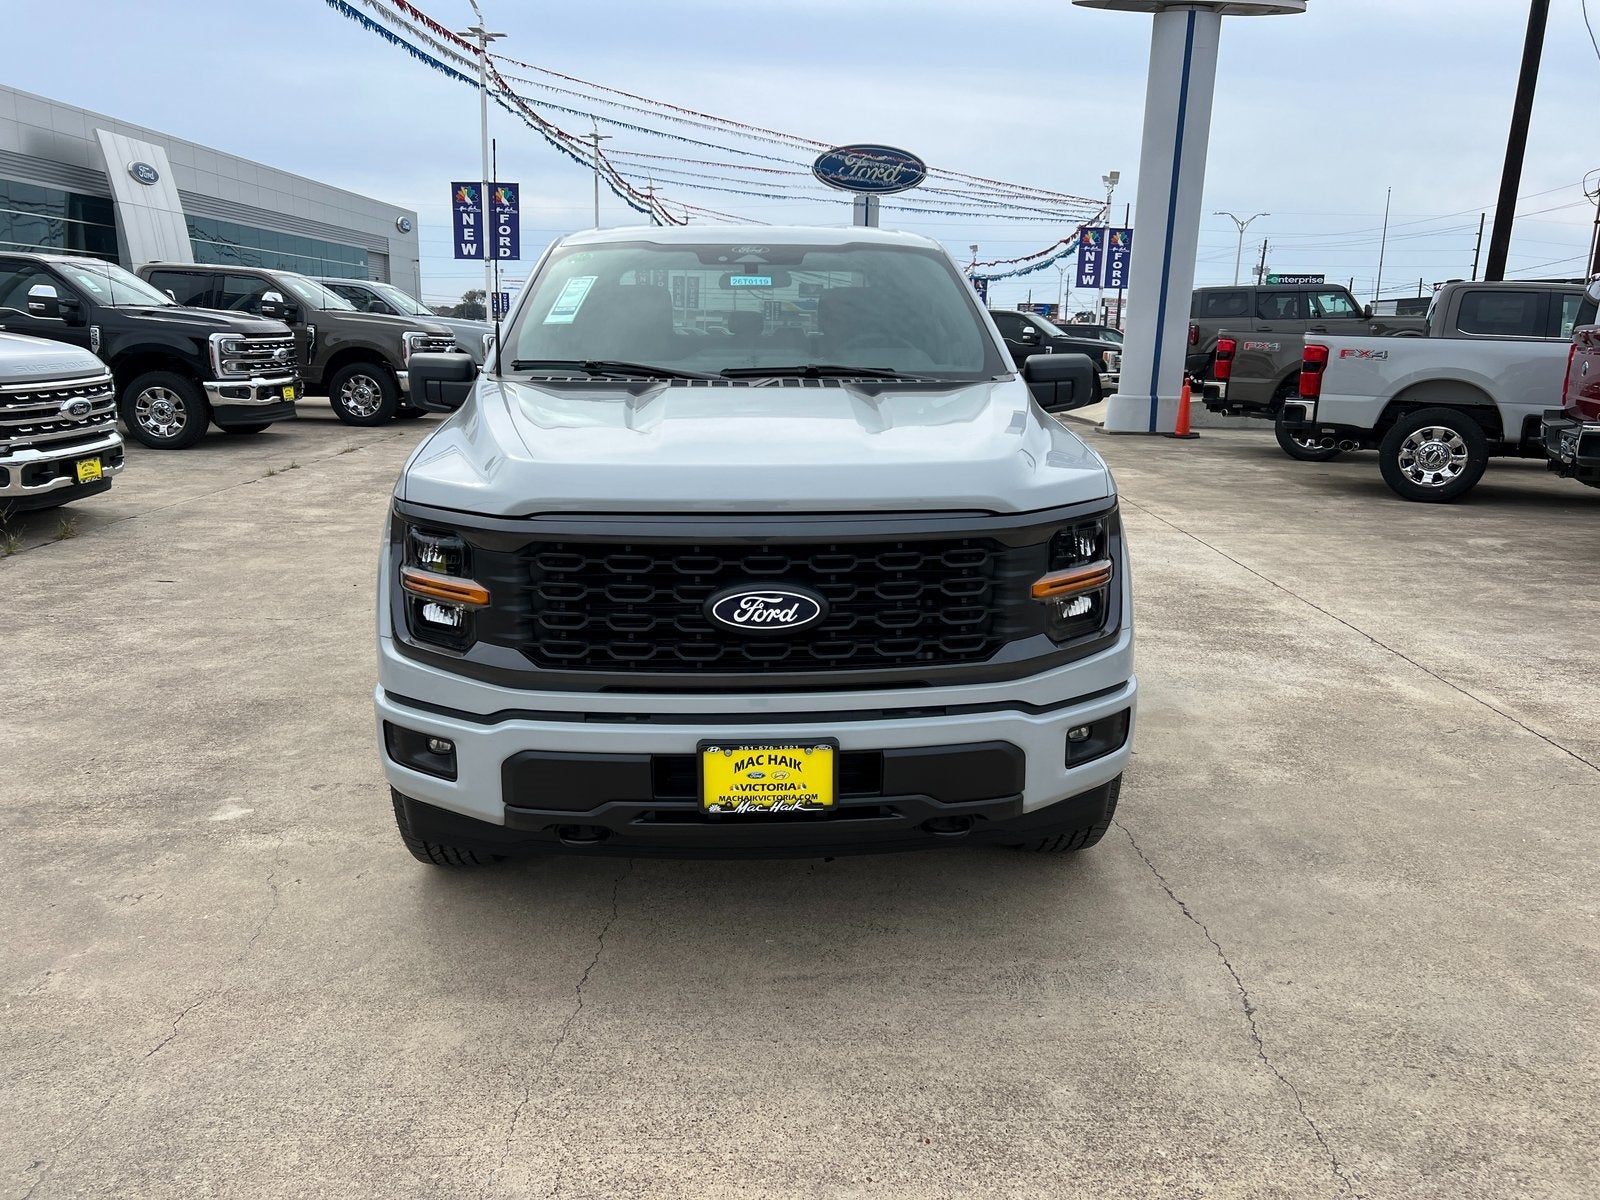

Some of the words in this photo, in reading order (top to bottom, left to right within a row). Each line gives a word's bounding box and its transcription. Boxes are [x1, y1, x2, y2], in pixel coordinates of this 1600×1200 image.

[838, 153, 904, 184] Ford
[460, 213, 477, 256] NEW
[498, 214, 512, 257] FORD
[1082, 251, 1096, 285] NEW
[1111, 252, 1123, 287] FORD
[1269, 275, 1324, 285] enterprise
[1243, 342, 1281, 351] FX4
[1339, 348, 1388, 361] FX4
[733, 596, 800, 622] Ford
[733, 754, 764, 773] MAC
[767, 754, 802, 773] HAIK
[739, 783, 797, 792] VICTORIA
[718, 793, 818, 802] MACHAIKVICTORIA.COM
[734, 800, 769, 814] Mac
[769, 800, 815, 813] Haik
